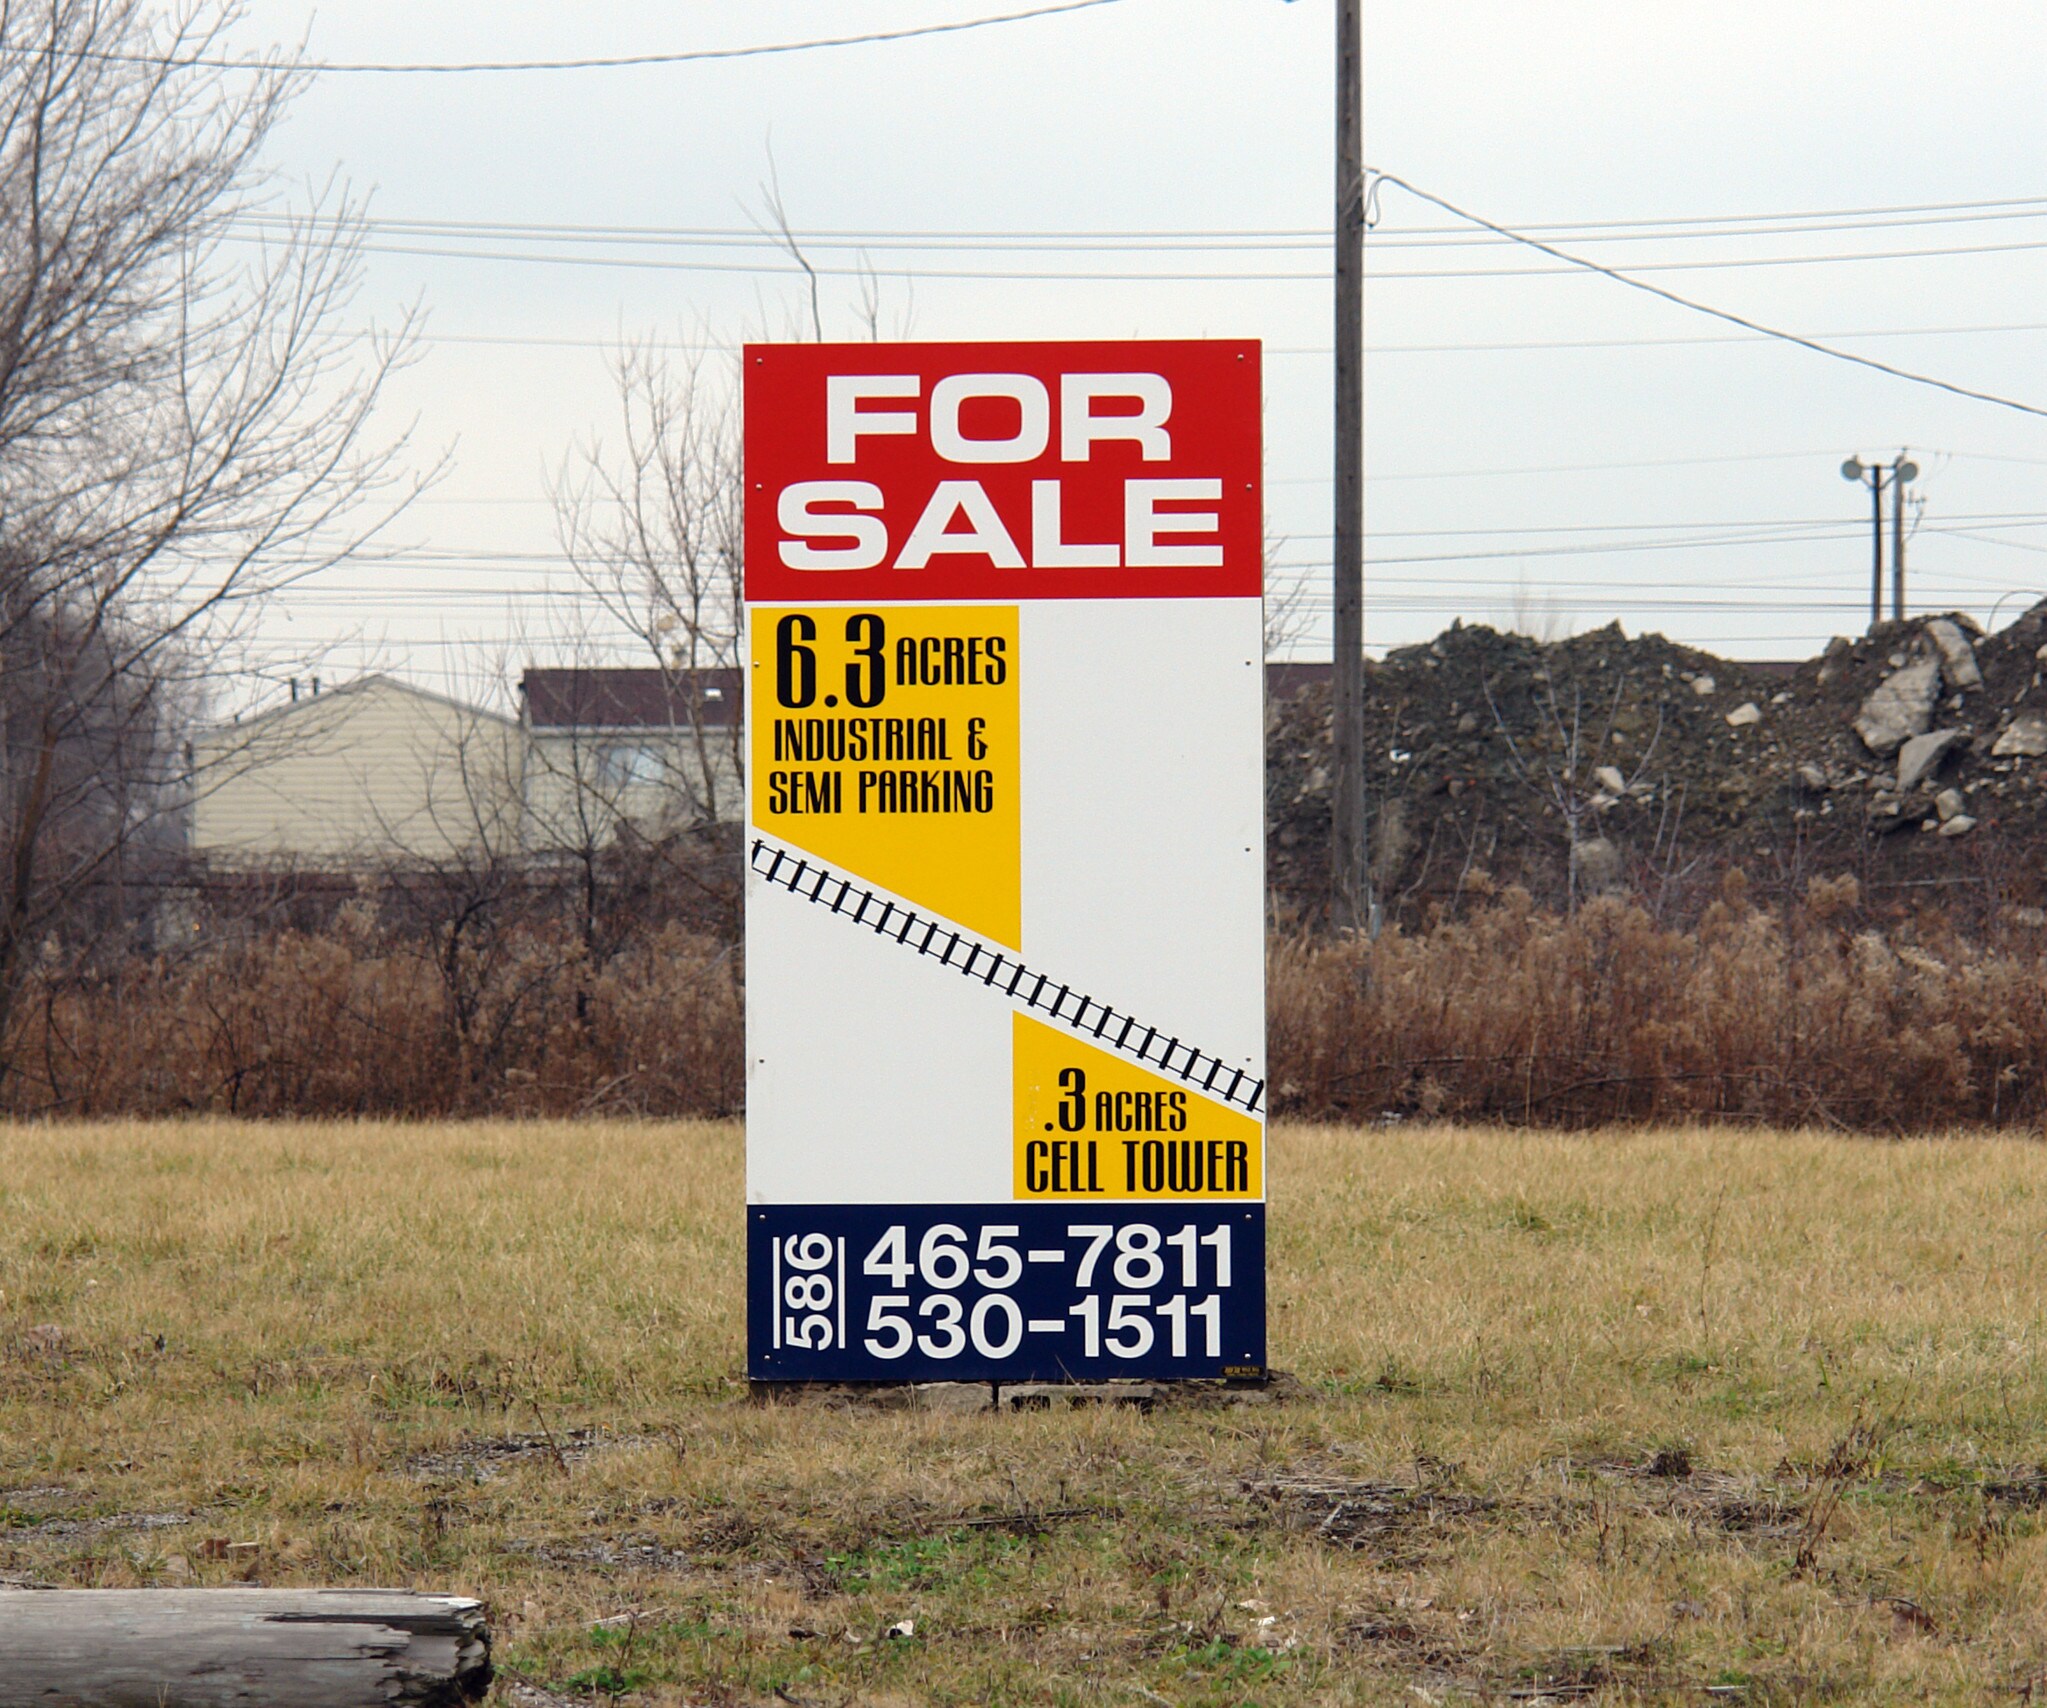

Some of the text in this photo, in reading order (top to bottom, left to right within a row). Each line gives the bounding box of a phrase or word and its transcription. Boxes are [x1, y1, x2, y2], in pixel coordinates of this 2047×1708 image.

[826, 372, 1173, 464] FOR
[777, 478, 1224, 570] SALE
[776, 613, 1006, 709] 6.3 ACRES
[774, 717, 988, 762] INDUSTRIAL &
[769, 769, 993, 814] SEMI PARKING
[1044, 1068, 1187, 1132] .3 ACRES
[1026, 1140, 1249, 1193] CELL TOWER
[863, 1223, 1232, 1290] 465-7811
[784, 1232, 834, 1352] 586
[863, 1294, 1221, 1359] 530-1511
